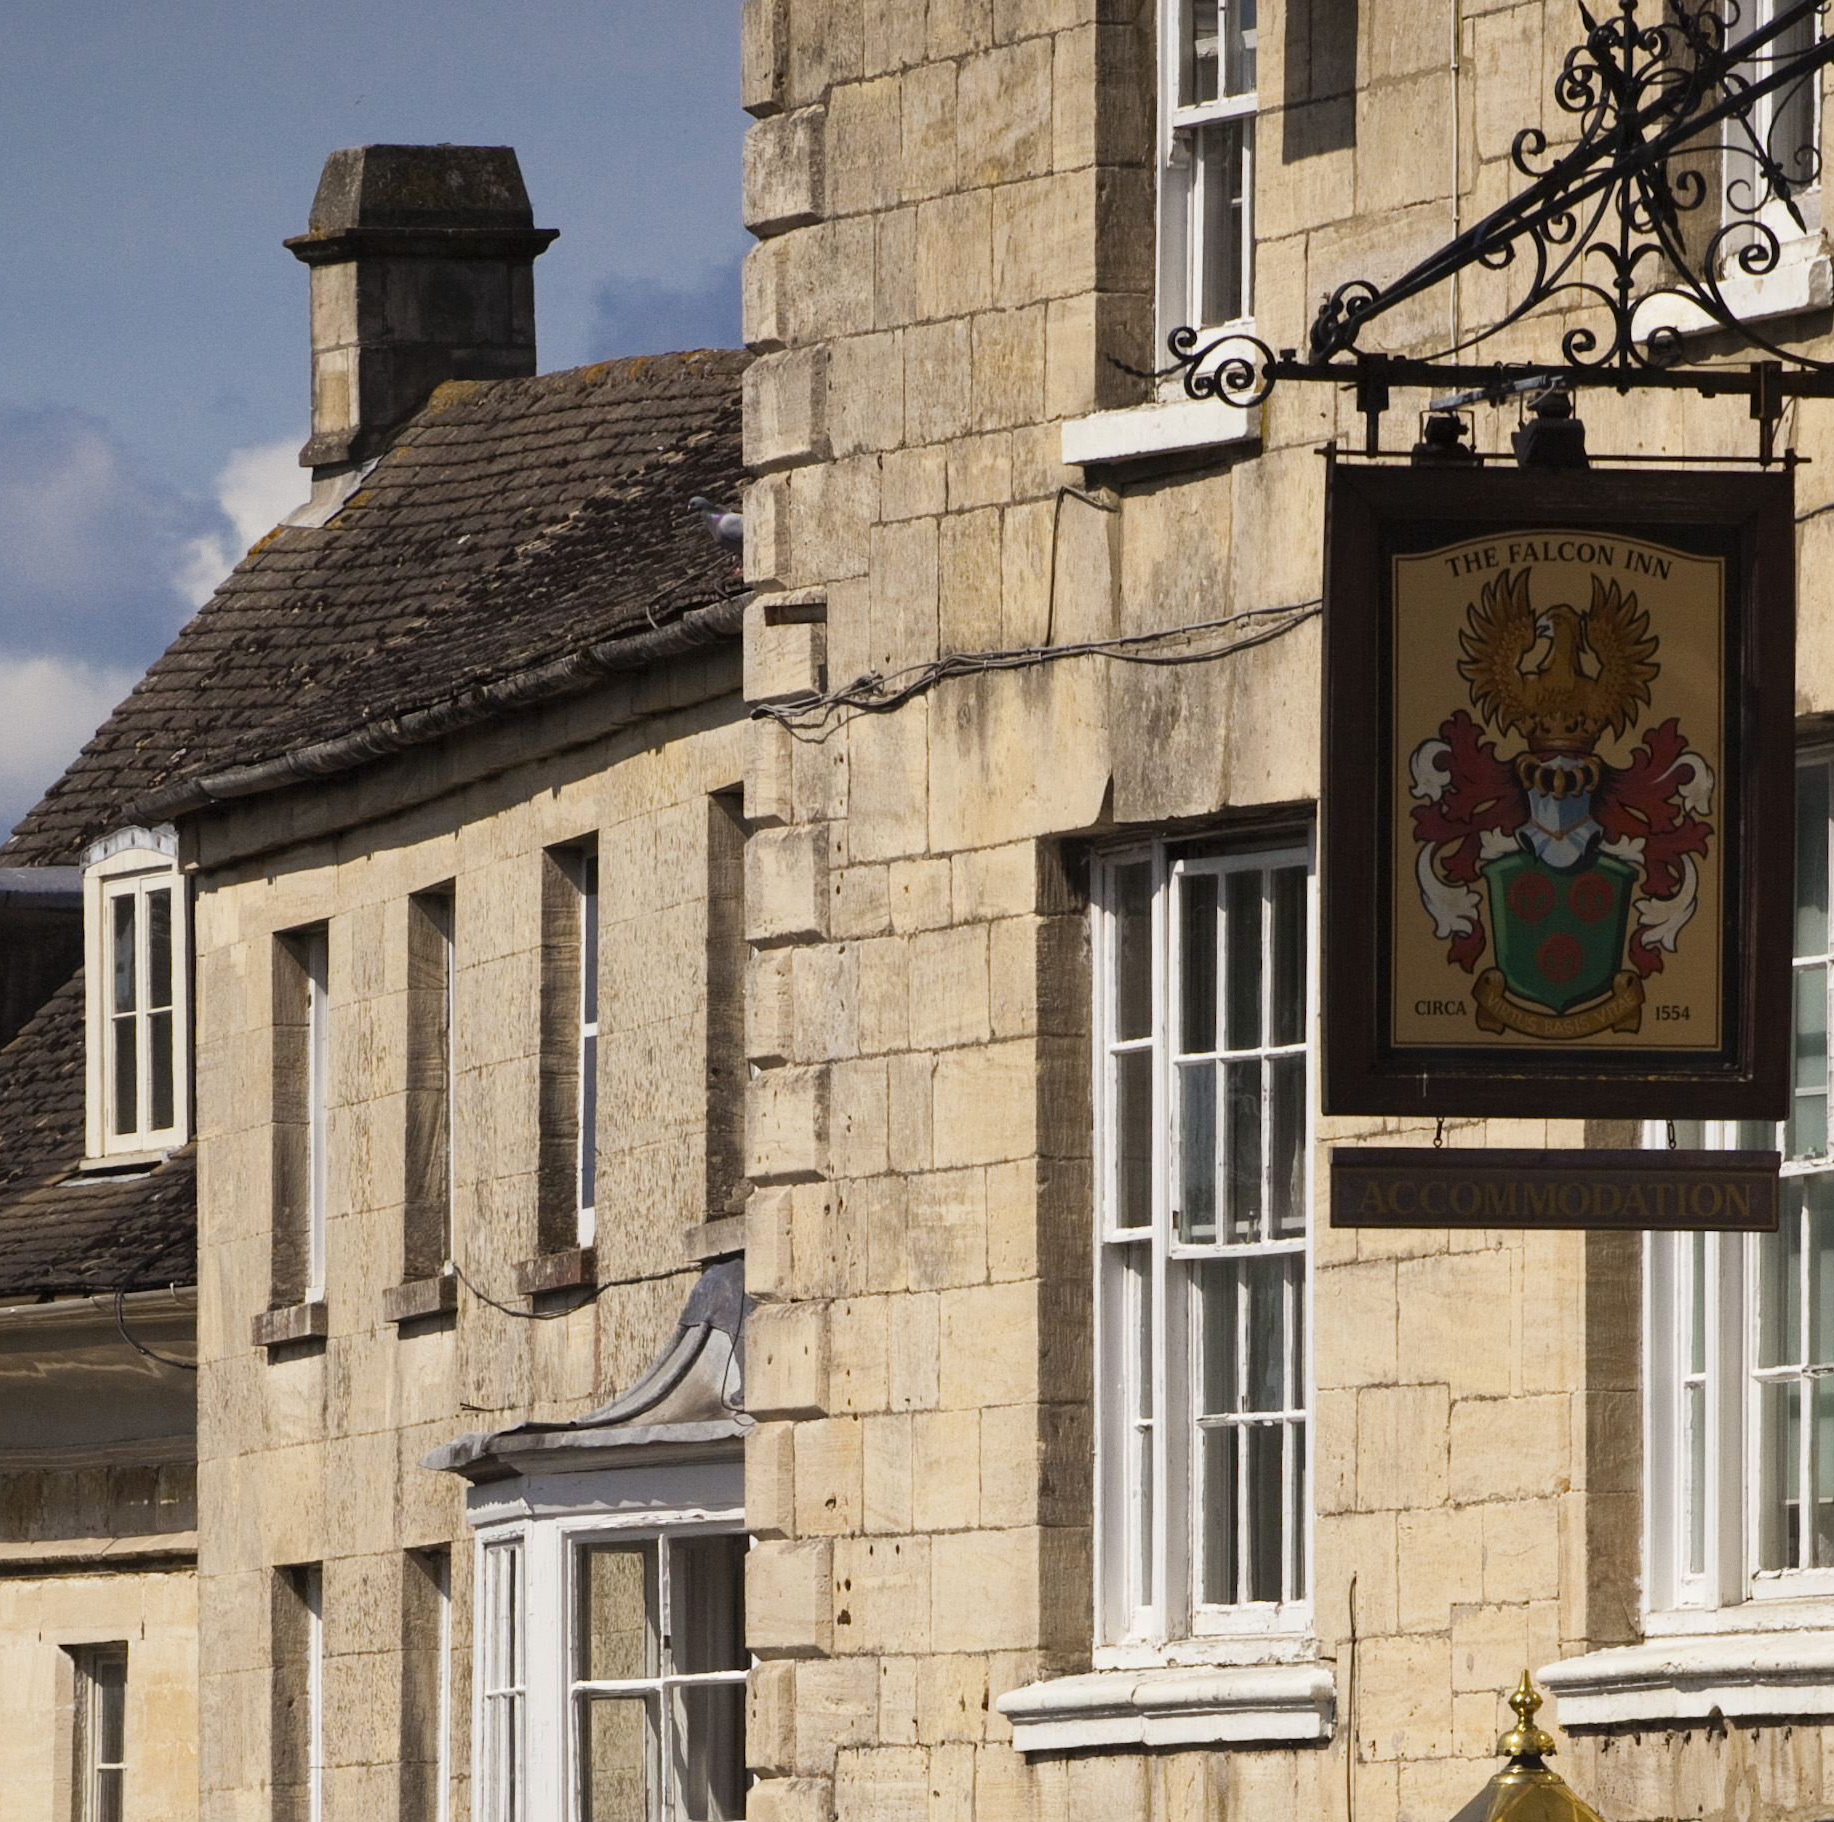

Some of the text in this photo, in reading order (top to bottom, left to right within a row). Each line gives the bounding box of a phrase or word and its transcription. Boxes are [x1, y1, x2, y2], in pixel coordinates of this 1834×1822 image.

[1445, 541, 1673, 580] THE FALCON INN
[1414, 1000, 1467, 1016] CIRCA
[1487, 992, 1635, 1035] VIRTUS BASIS VITAE
[1655, 1006, 1691, 1021] 1554
[1358, 1181, 1752, 1217] ACCOMMODATION
